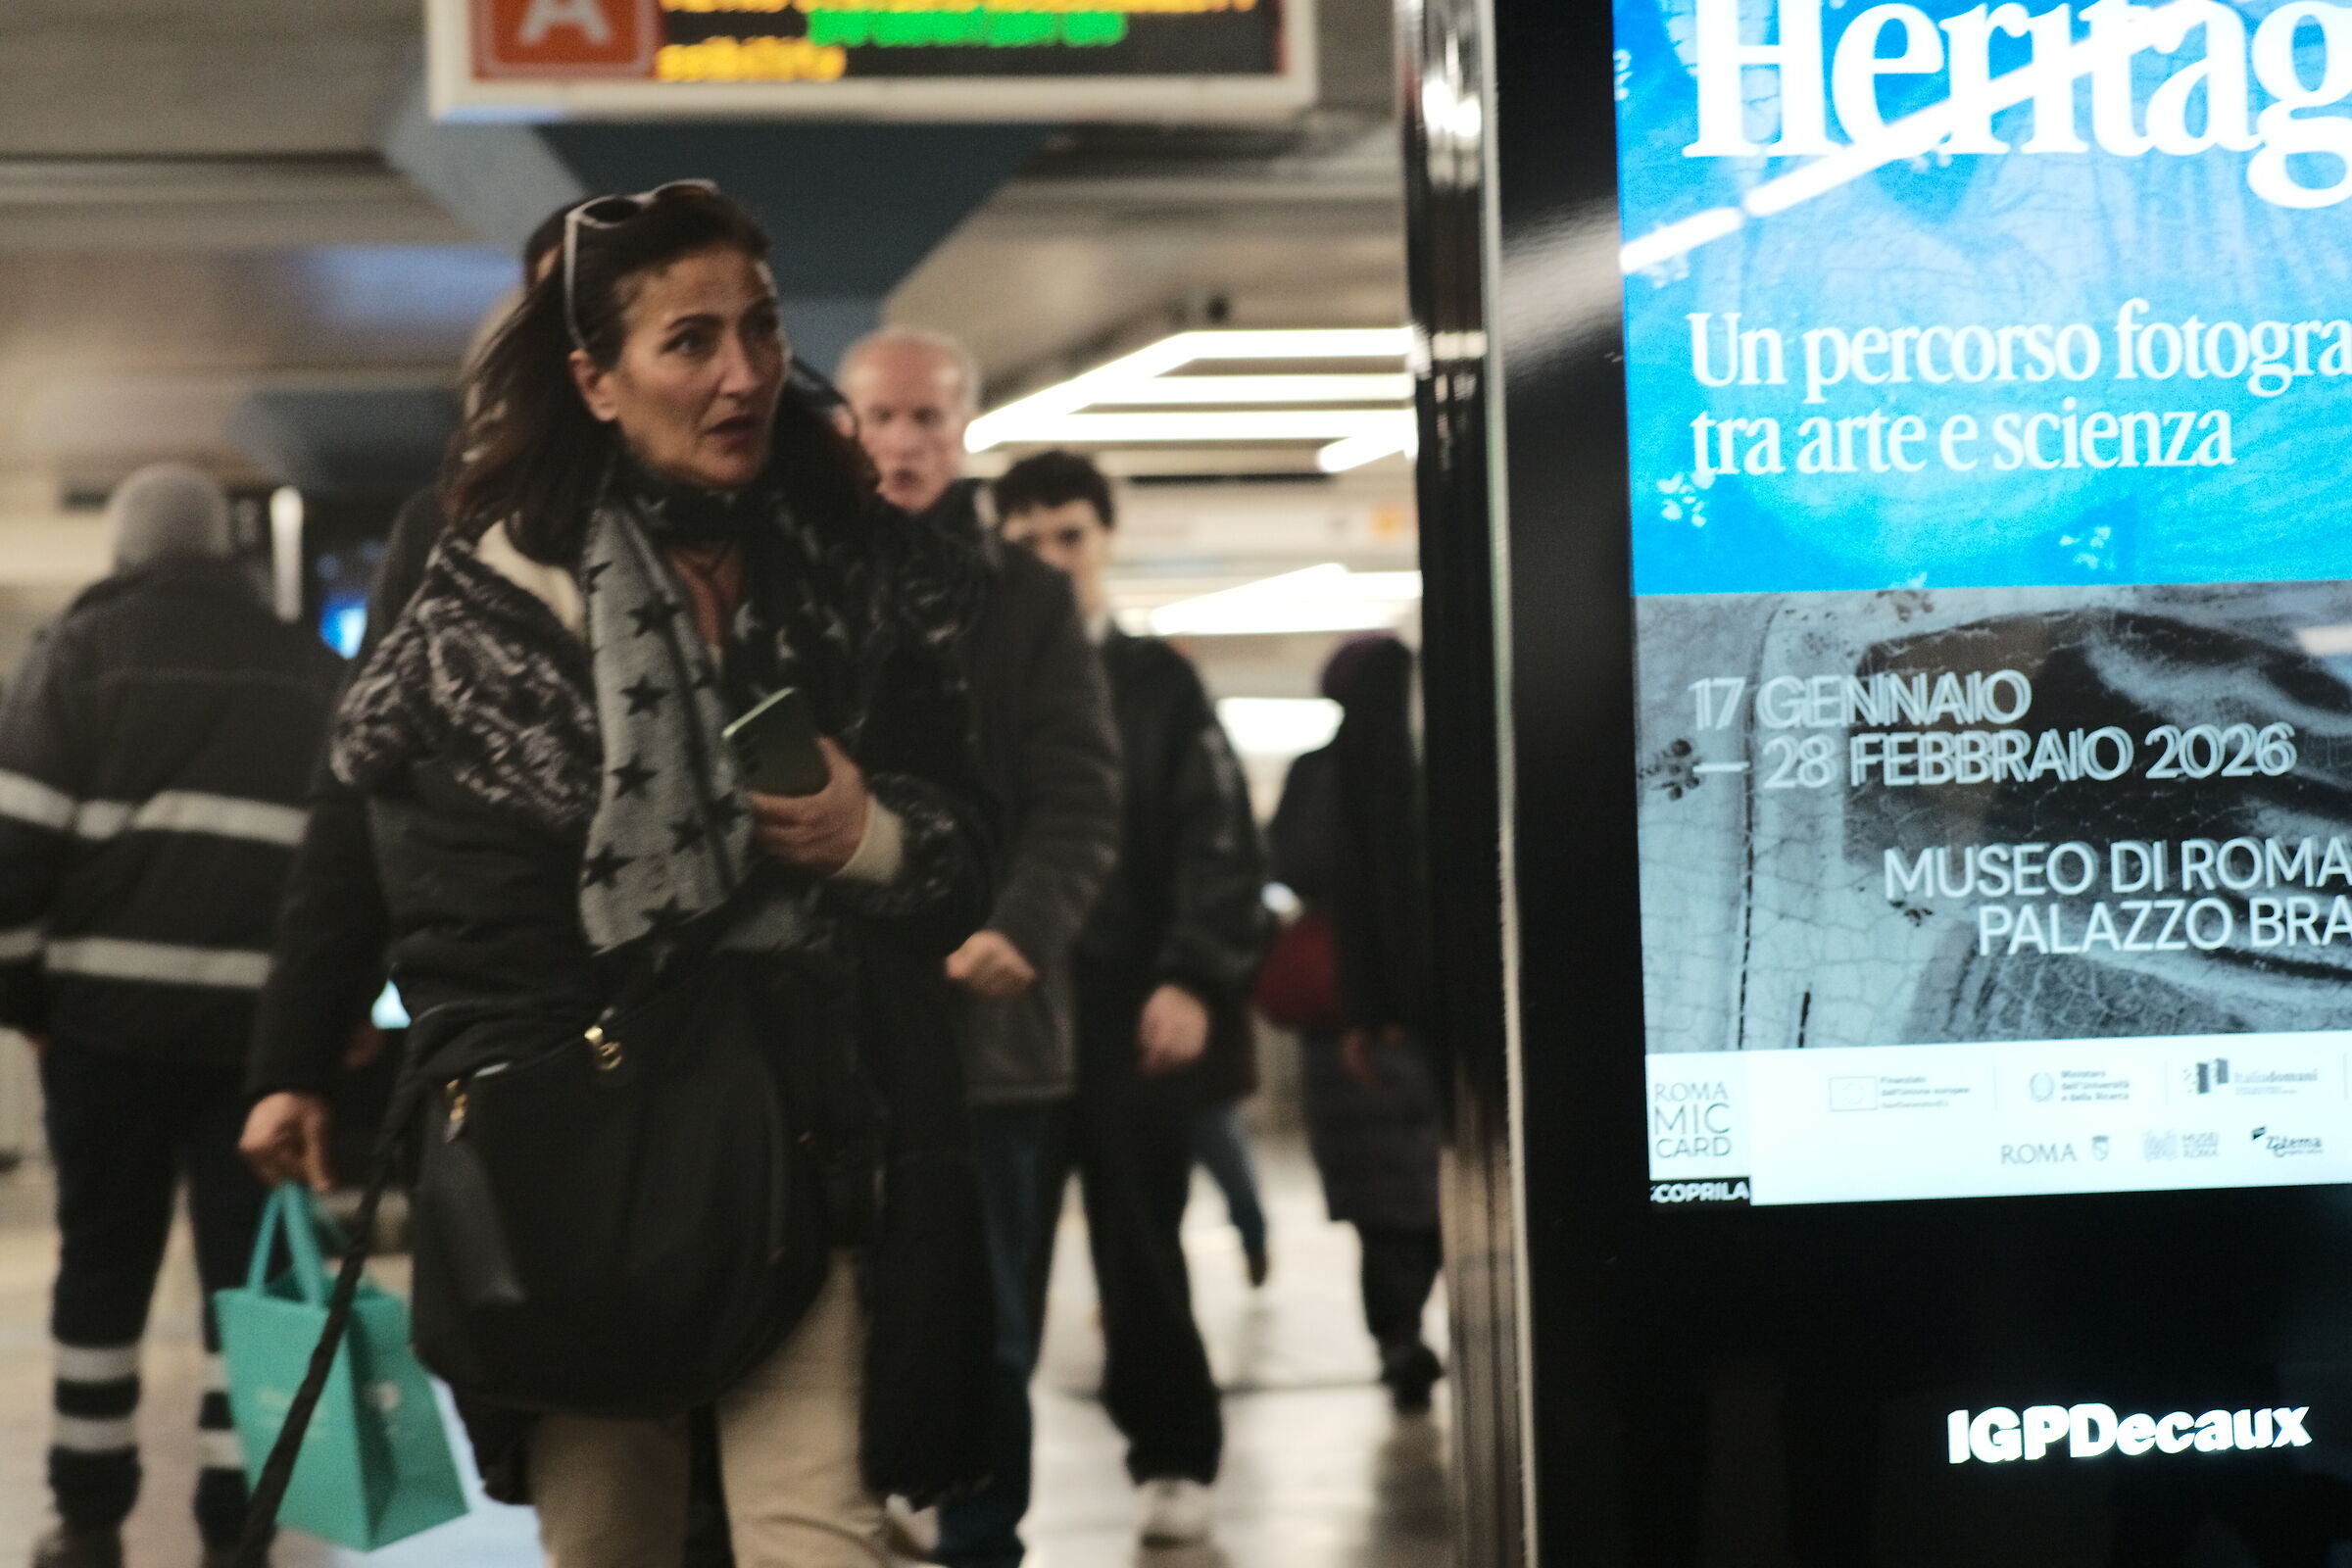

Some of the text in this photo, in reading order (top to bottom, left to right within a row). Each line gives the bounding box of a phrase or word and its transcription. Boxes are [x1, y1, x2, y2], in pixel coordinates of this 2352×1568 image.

[1686, 297, 2352, 405] Un percorso fotogra
[1690, 397, 2237, 476] tra arte e scienza
[1689, 668, 2034, 731] 17 GENNAIO
[1762, 734, 1838, 790] 28
[1848, 726, 2134, 788] FEBBRAIO
[2144, 721, 2298, 781] 2026
[1884, 836, 2352, 901] MUSEO DI ROMA
[1978, 894, 2352, 956] PALAZZO BRA
[1653, 1102, 1733, 1136] MIC
[1654, 1082, 1729, 1102] ROMA
[1656, 1137, 1733, 1159] CARD
[2000, 1143, 2078, 1164] ROMA
[1650, 1181, 1749, 1203] COPRILA
[1947, 1402, 2312, 1464] IGPDecaux
